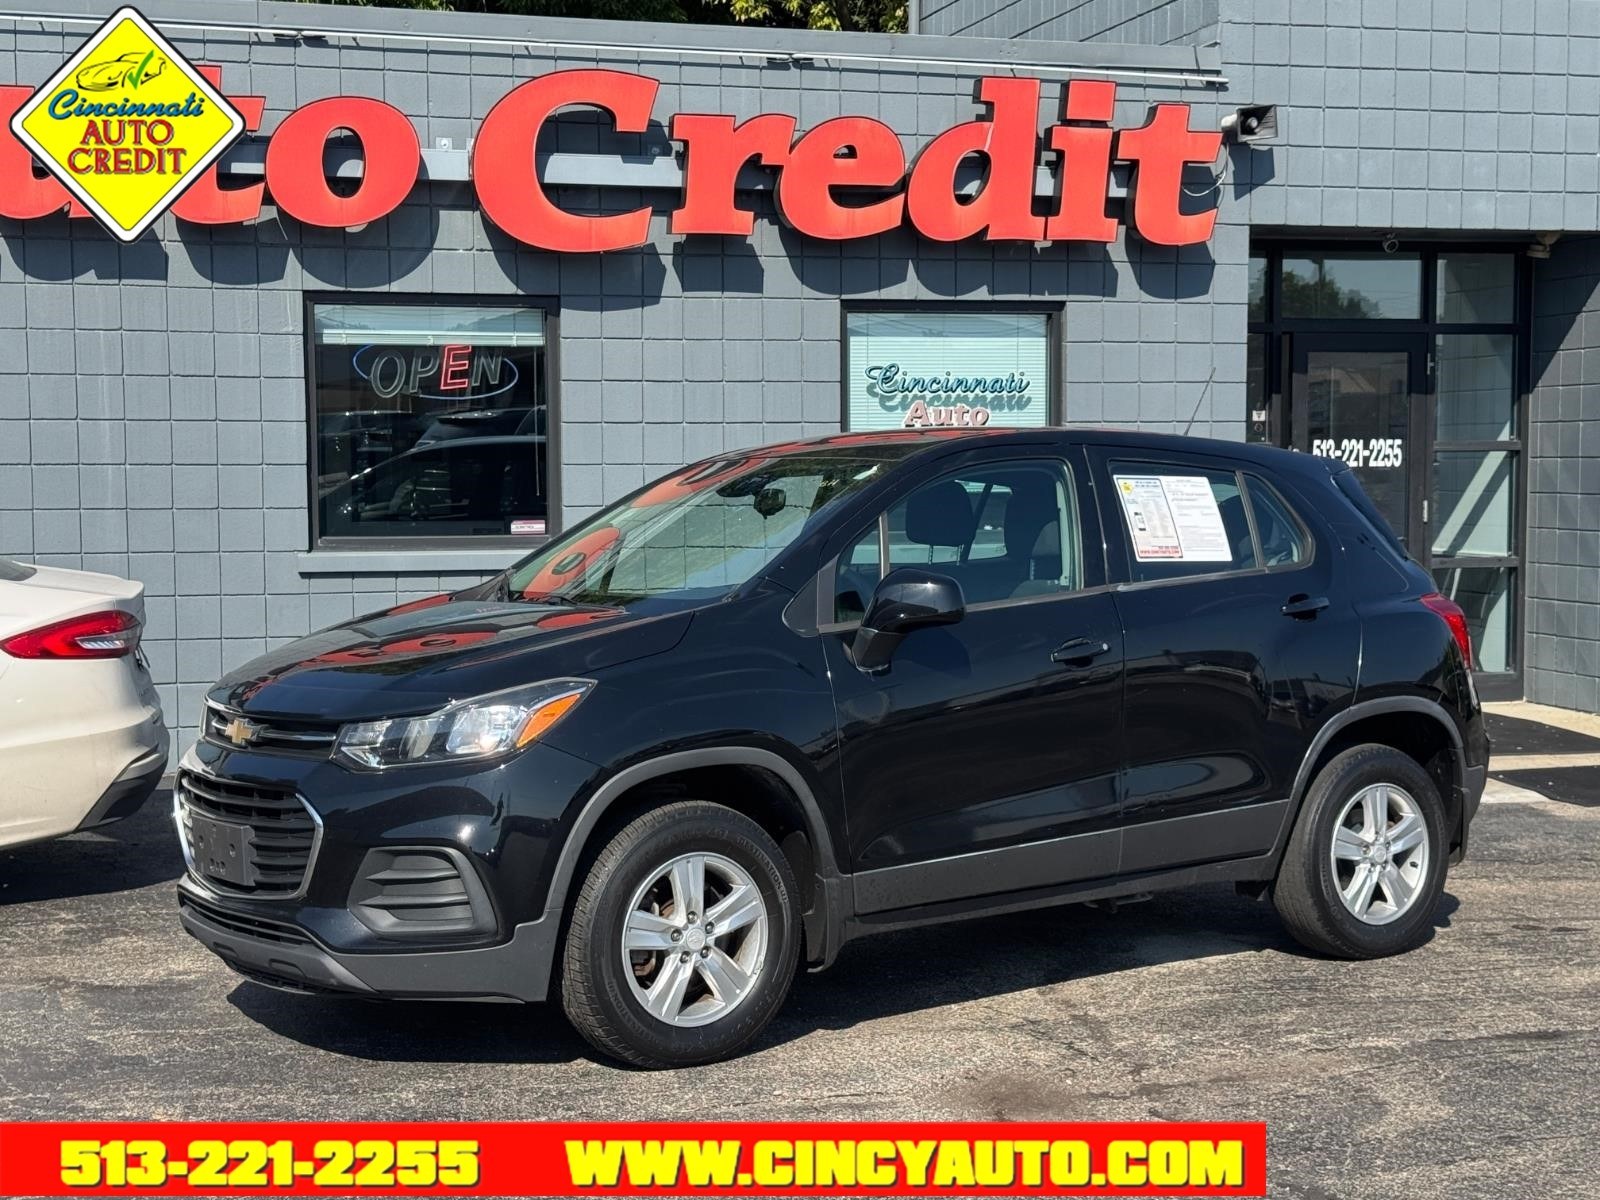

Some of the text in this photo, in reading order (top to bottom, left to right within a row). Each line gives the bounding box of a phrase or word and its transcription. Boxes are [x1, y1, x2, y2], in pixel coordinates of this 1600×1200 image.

[472, 70, 1222, 253] Credit
[369, 343, 505, 399] OPEN
[865, 362, 1031, 395] Cincinnati
[903, 399, 990, 428] Auto
[1312, 438, 1403, 468] 513-221-2255
